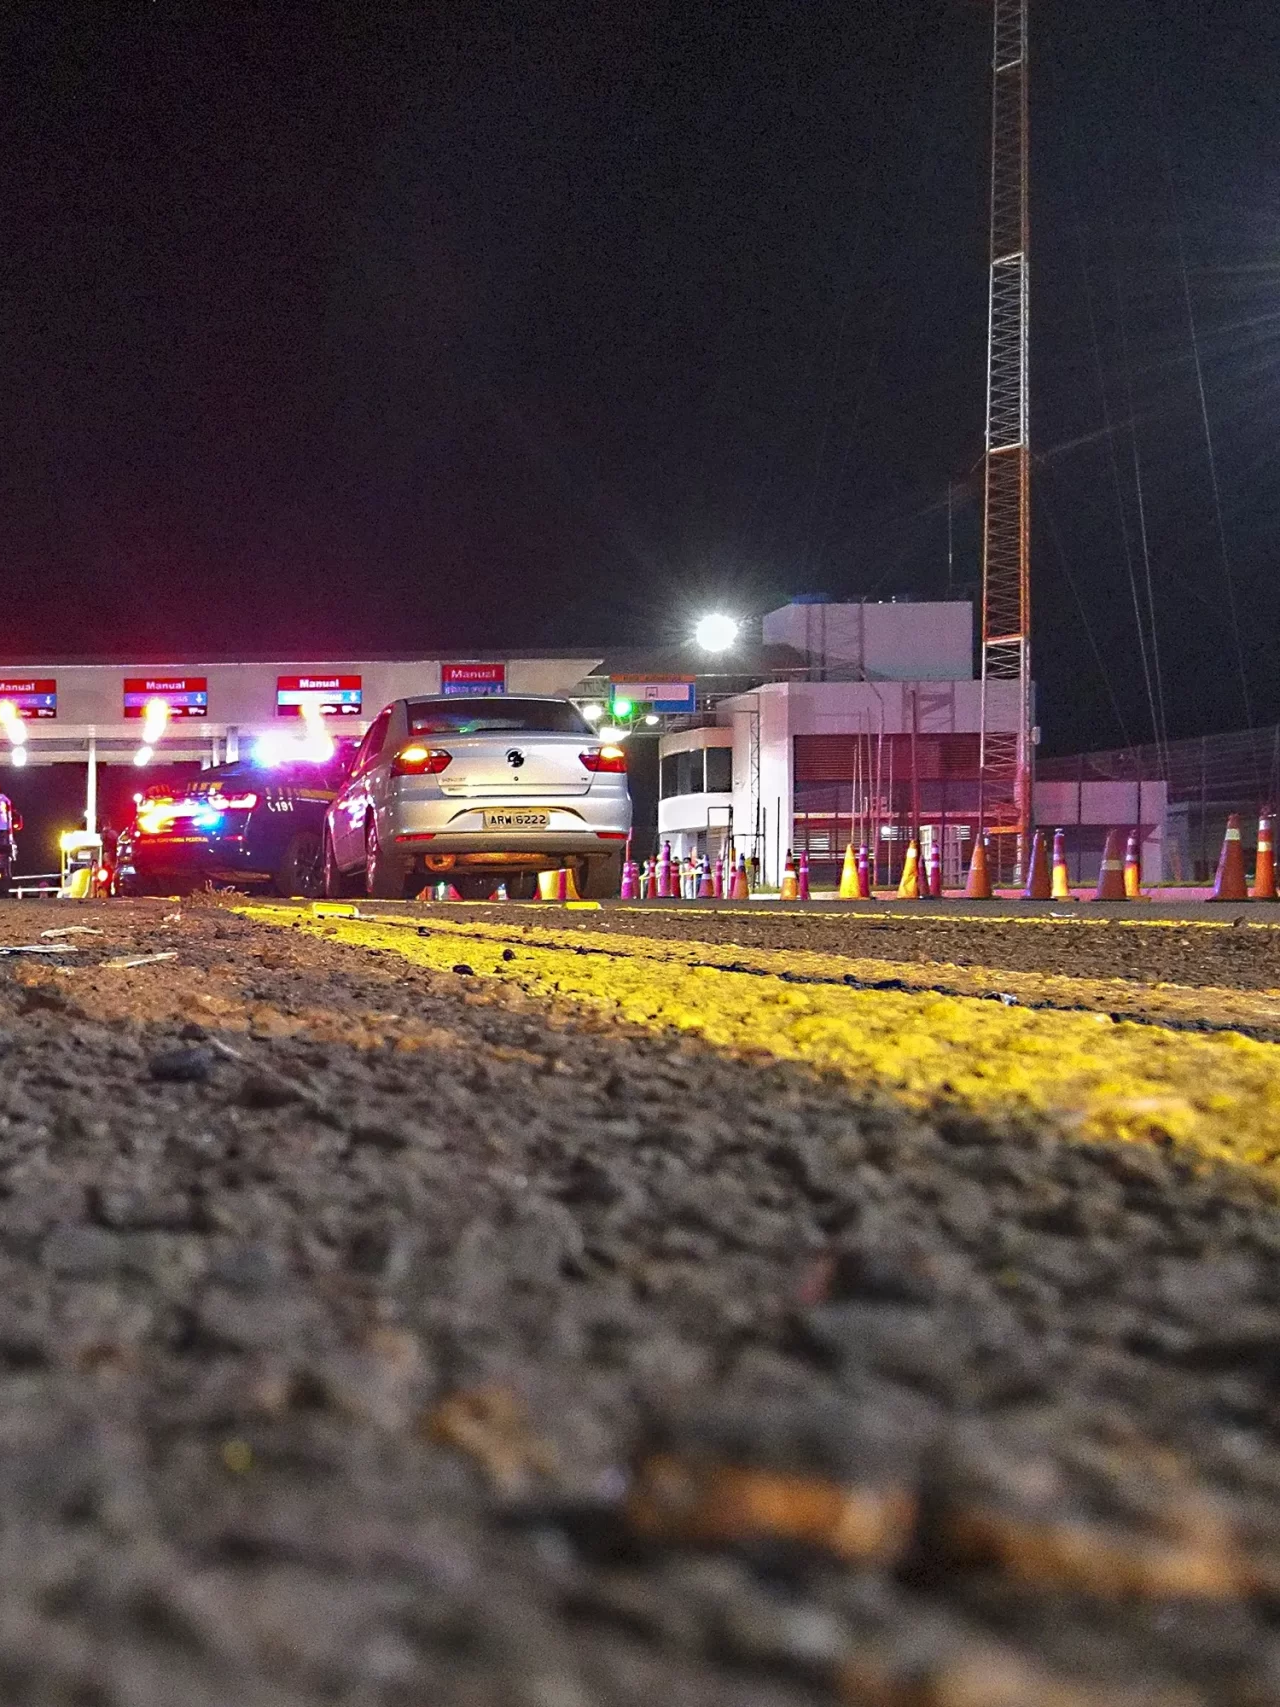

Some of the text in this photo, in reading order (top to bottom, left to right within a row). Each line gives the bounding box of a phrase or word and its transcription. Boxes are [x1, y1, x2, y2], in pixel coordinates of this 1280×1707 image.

[451, 669, 496, 678] Manual
[146, 681, 185, 690] Manual
[299, 679, 339, 688] Manual
[275, 801, 294, 812] 191
[490, 815, 547, 824] ARW 6222
